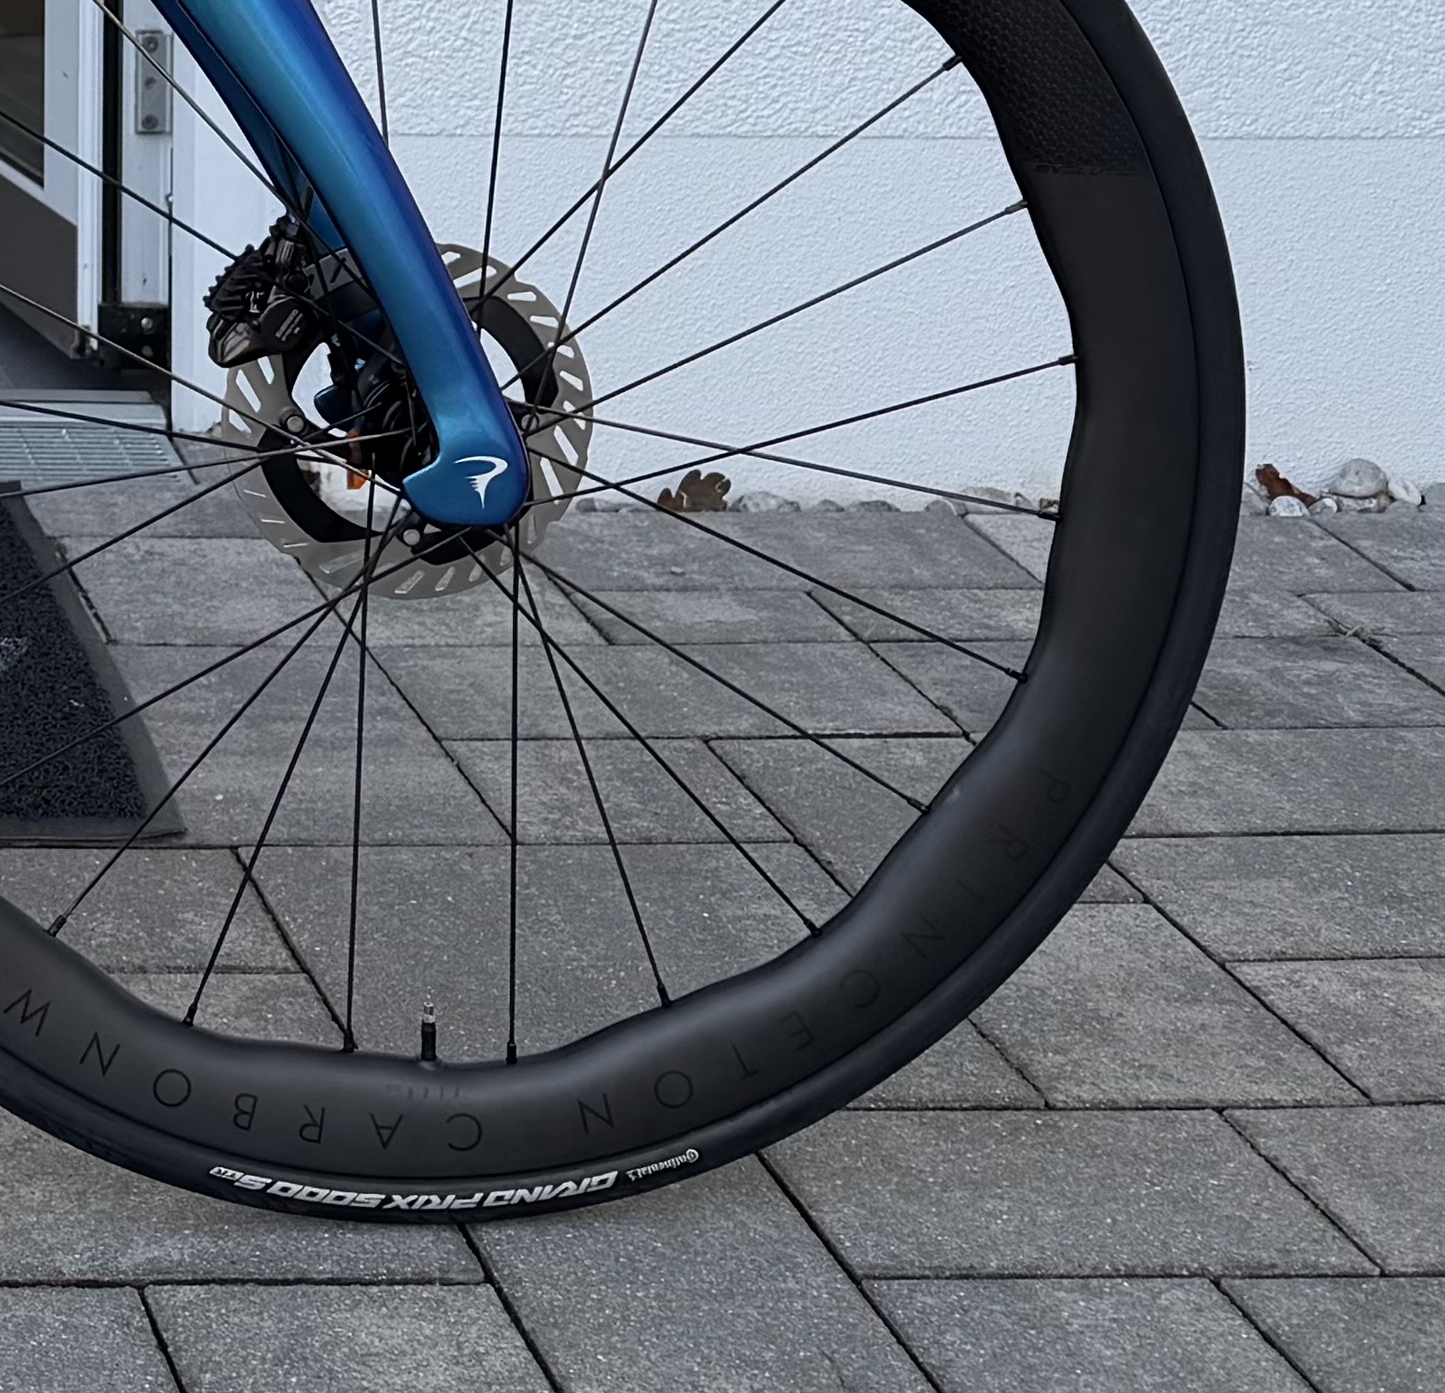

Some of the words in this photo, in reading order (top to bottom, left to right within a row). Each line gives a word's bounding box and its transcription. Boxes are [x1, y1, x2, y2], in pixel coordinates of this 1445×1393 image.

[264, 1179, 385, 1208] 5000
[385, 1192, 483, 1210] PRIX
[482, 1170, 620, 1205] GRAND
